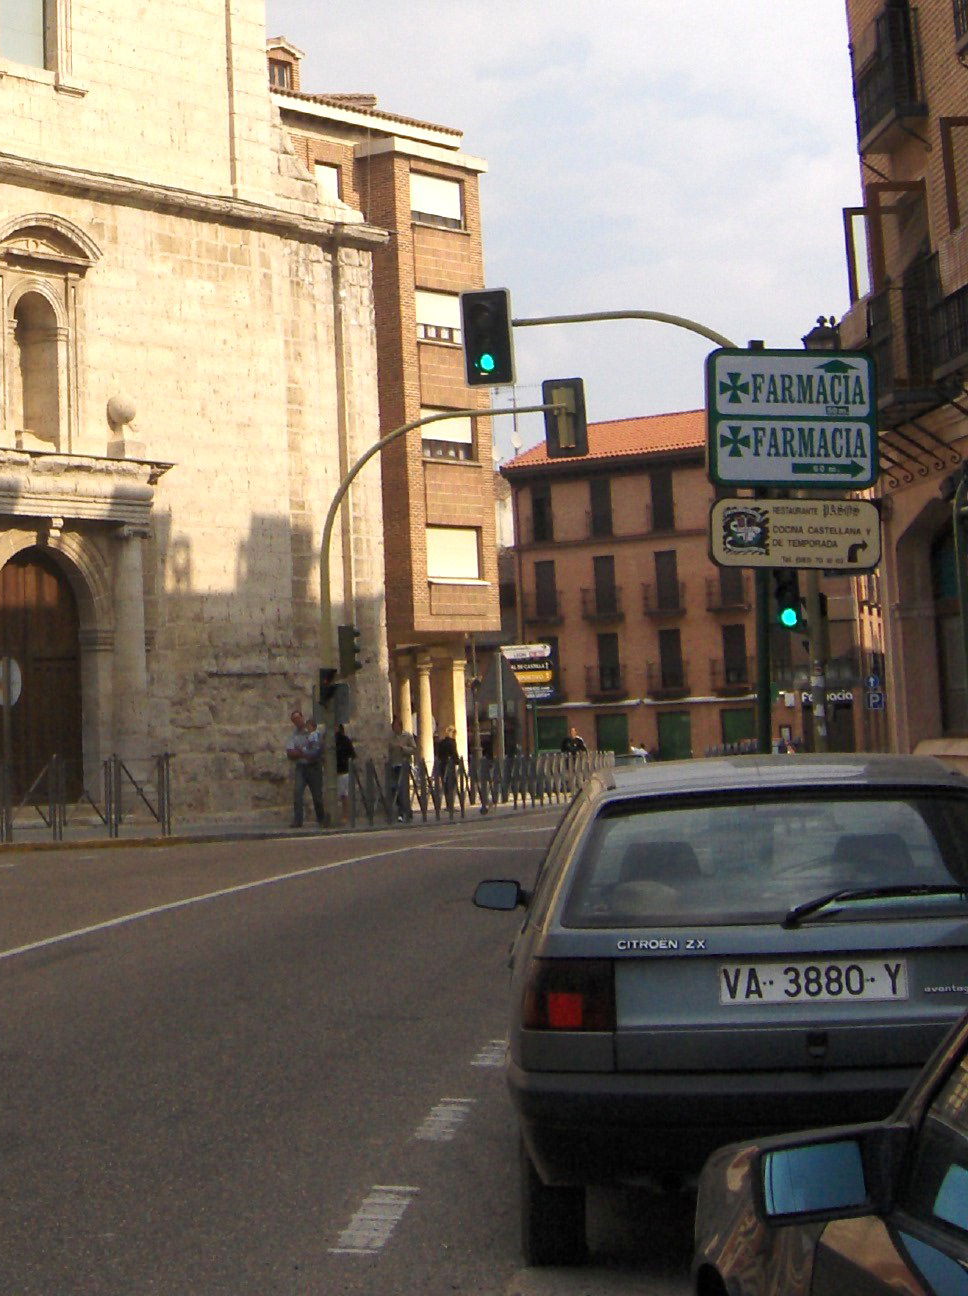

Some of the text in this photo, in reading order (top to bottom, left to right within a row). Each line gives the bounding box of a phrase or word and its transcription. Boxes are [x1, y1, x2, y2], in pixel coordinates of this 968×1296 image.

[751, 373, 866, 404] FARMACIA
[752, 426, 867, 458] FARMACIA
[772, 506, 818, 515] RESTAURANTE
[772, 525, 804, 534] COCINA
[808, 526, 861, 535] CASTELLANA
[772, 538, 838, 548] DE TEMPORADA
[617, 937, 706, 950] CITROËN ZX
